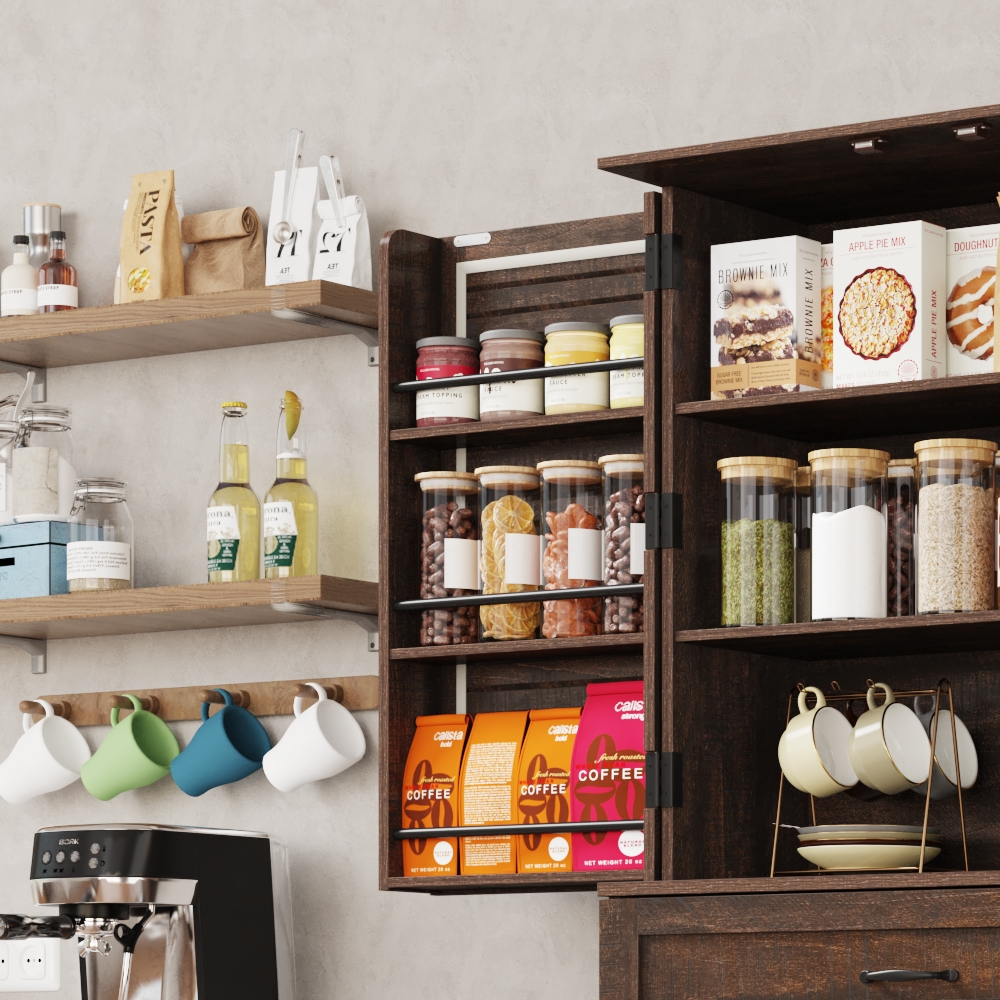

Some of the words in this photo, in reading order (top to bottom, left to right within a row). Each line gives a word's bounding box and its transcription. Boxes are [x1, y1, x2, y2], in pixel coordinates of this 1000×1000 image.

[139, 189, 160, 254] PASTA
[848, 240, 874, 252] APPLE
[876, 238, 889, 249] PIE
[891, 236, 906, 247] MIX
[954, 238, 999, 252] DOUGHNUT
[718, 264, 765, 284] BROWNIE
[770, 262, 789, 279] MIX
[804, 268, 814, 291] MIX
[804, 296, 814, 354] BROWNIE
[628, 371, 644, 379] TOPP
[716, 371, 731, 379] SUGAR
[614, 700, 644, 712] Calis
[578, 767, 643, 782] COFFEE
[407, 789, 451, 801] COFFEE
[521, 784, 567, 796] COFFEE
